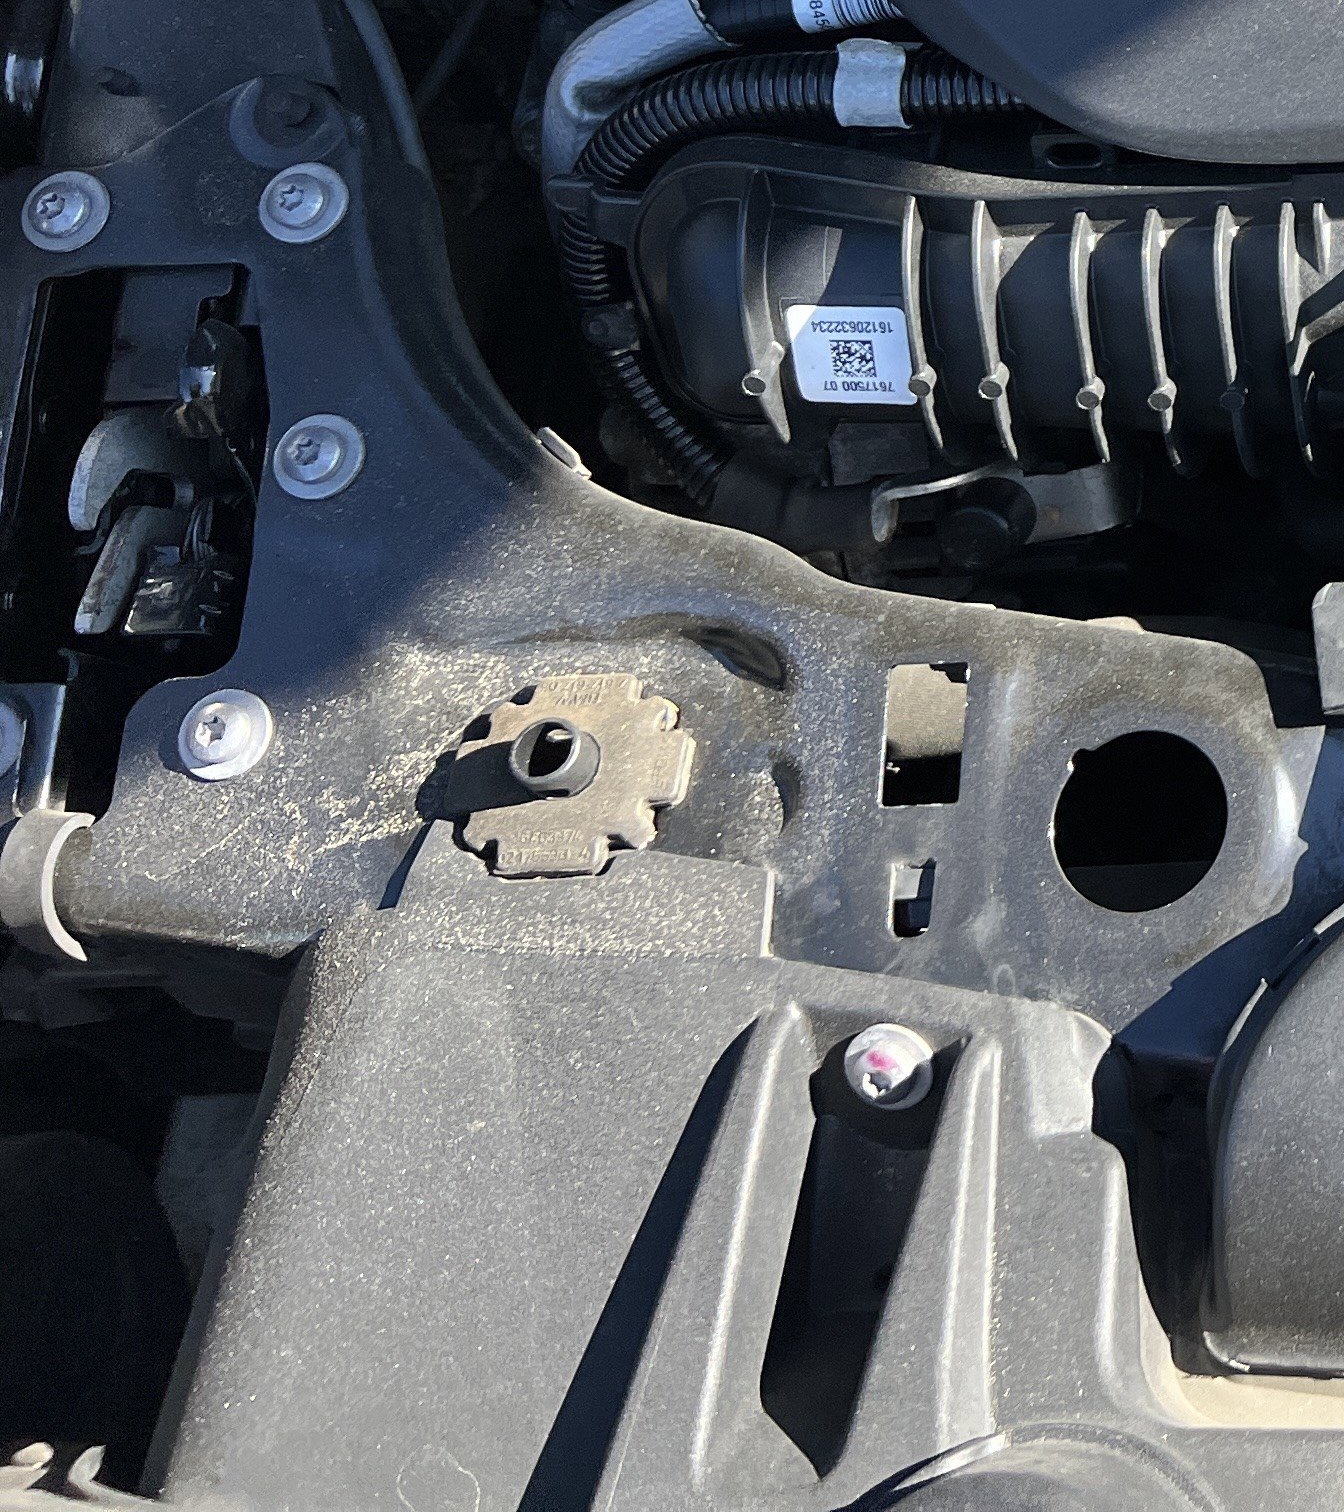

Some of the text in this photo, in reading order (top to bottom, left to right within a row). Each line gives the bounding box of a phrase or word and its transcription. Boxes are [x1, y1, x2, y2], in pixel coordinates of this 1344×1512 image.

[810, 320, 894, 334] 16120632234
[823, 380, 896, 393] 7617500 07
